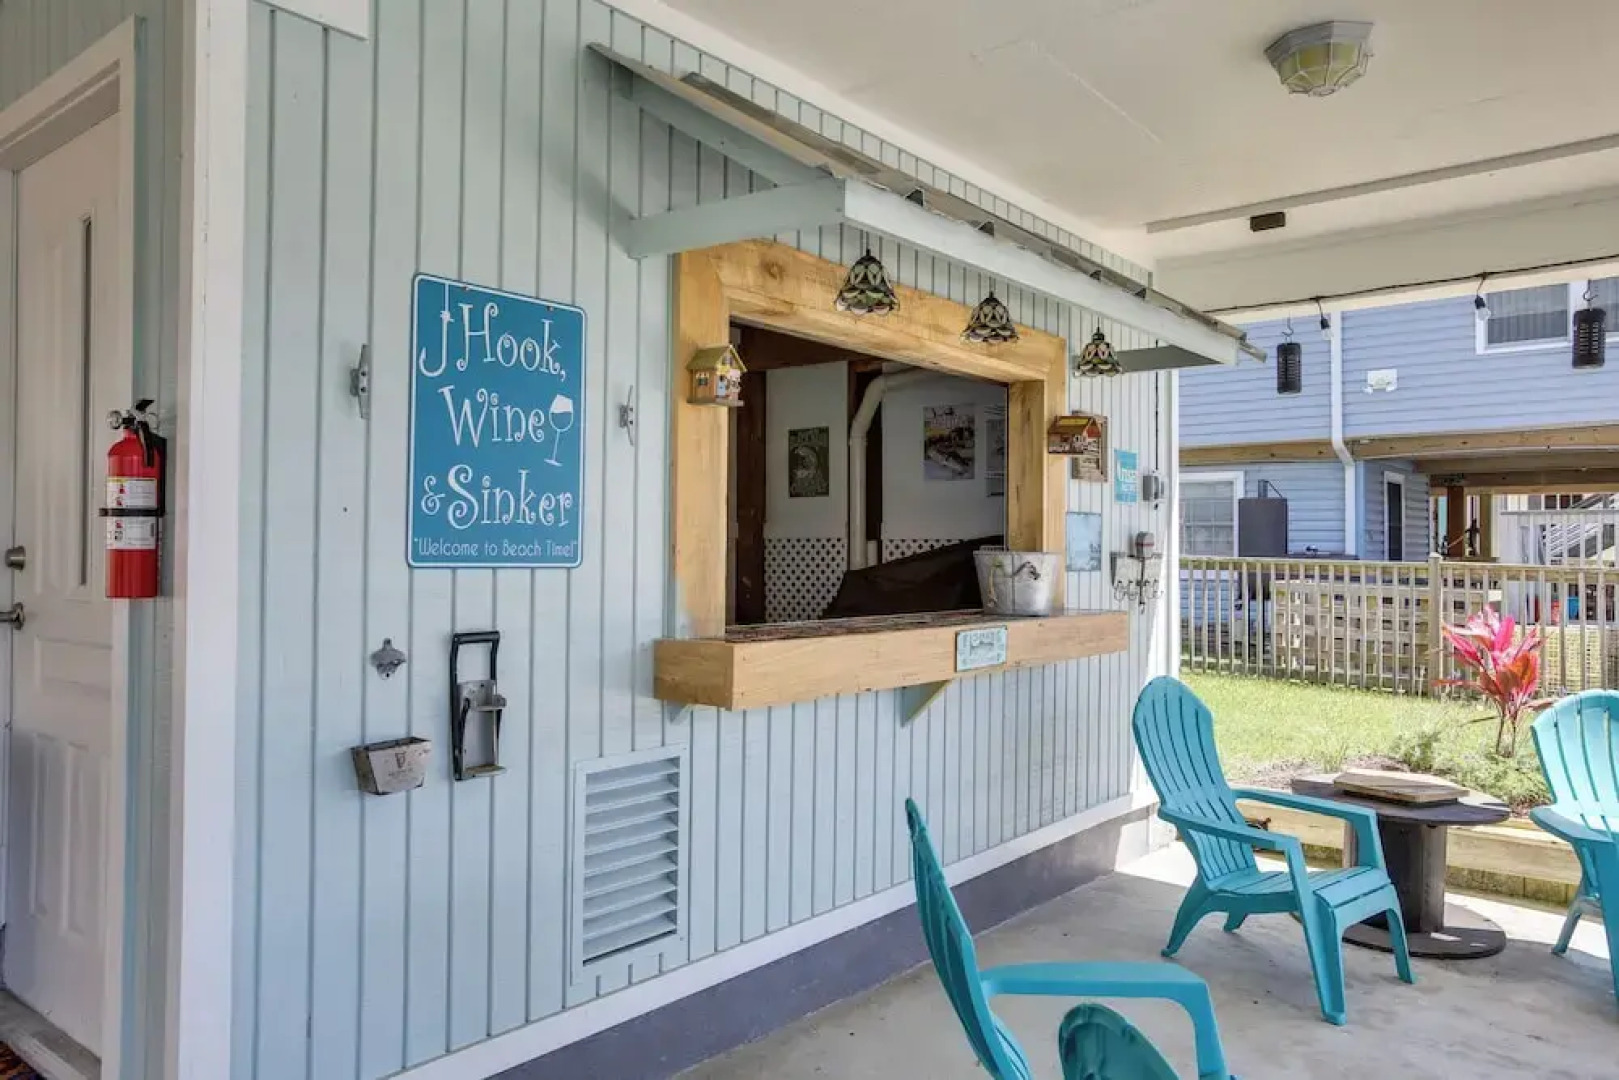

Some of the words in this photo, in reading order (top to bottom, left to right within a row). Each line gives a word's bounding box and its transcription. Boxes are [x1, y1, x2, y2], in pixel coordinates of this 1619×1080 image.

[456, 302, 566, 382] Hook,
[437, 385, 545, 447] Wine
[421, 475, 446, 515] &
[448, 464, 573, 529] Sinker
[484, 539, 498, 556] to
[502, 539, 541, 556] Beach
